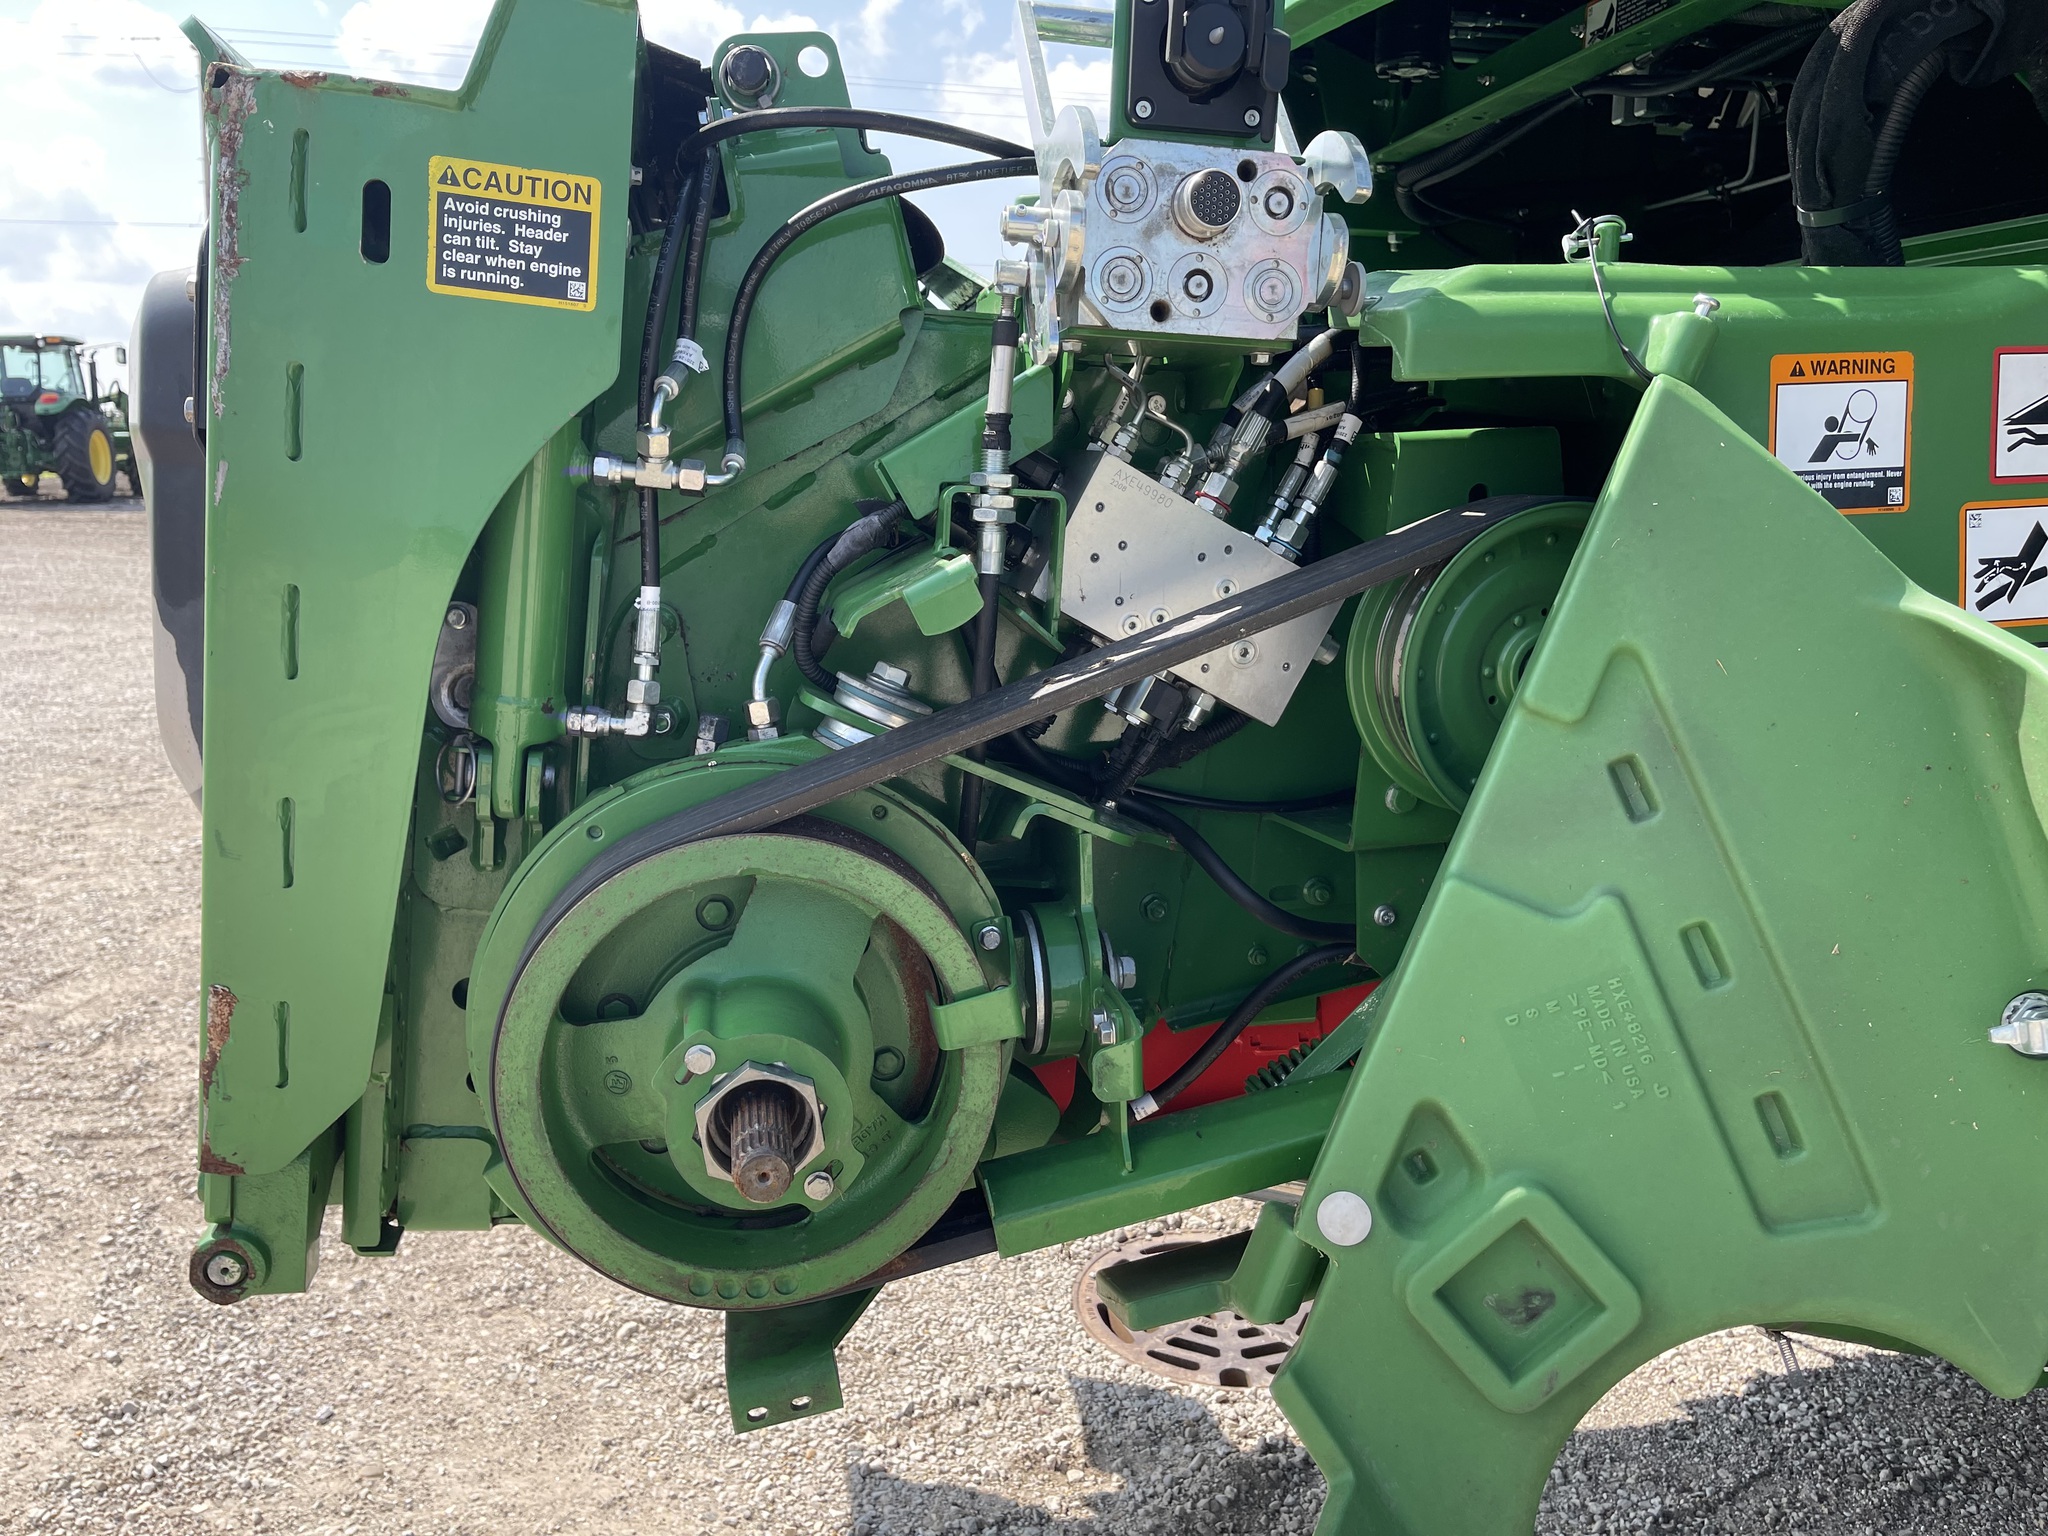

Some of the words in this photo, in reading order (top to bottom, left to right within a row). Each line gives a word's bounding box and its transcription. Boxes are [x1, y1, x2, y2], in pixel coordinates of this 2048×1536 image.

[462, 167, 592, 205] CAUTION
[865, 177, 939, 200] ALFAGOMMA
[443, 197, 490, 216] Avoid
[493, 206, 561, 228] crushing
[692, 196, 707, 242] ITALY
[443, 214, 506, 235] injuries.
[514, 223, 569, 243] Header
[442, 233, 471, 247] can
[475, 235, 500, 251] tilt.
[508, 239, 543, 259] Stay
[662, 235, 673, 254] 857
[442, 248, 482, 265] clear
[485, 254, 526, 271] when
[529, 261, 582, 278] engine
[657, 259, 668, 274] EN
[688, 250, 699, 267] IN
[744, 270, 760, 296] MADE
[758, 254, 770, 270] IN
[769, 229, 793, 257] ITALY
[442, 264, 457, 278] is
[460, 269, 525, 290] running.
[684, 274, 696, 307] MADE
[645, 320, 654, 339] 100
[1810, 358, 1896, 377] WARNING
[1109, 478, 1128, 493] 2208
[1815, 473, 1832, 482] injury
[1832, 472, 1846, 480] from
[1846, 470, 1885, 480] entanglement.
[1886, 469, 1903, 478] Never
[1824, 481, 1833, 489] the
[1833, 481, 1852, 490] engine
[1853, 480, 1876, 489] running.
[1113, 468, 1174, 509] AXE49980
[640, 500, 649, 521] MPa
[1525, 1007, 1540, 1019] S
[1545, 999, 1562, 1014] M
[1504, 1013, 1520, 1026] D
[1608, 977, 1655, 1065] HXE48216
[1586, 984, 1617, 1031] MADE
[1609, 1038, 1629, 1058] IN
[1622, 1063, 1646, 1099] USA
